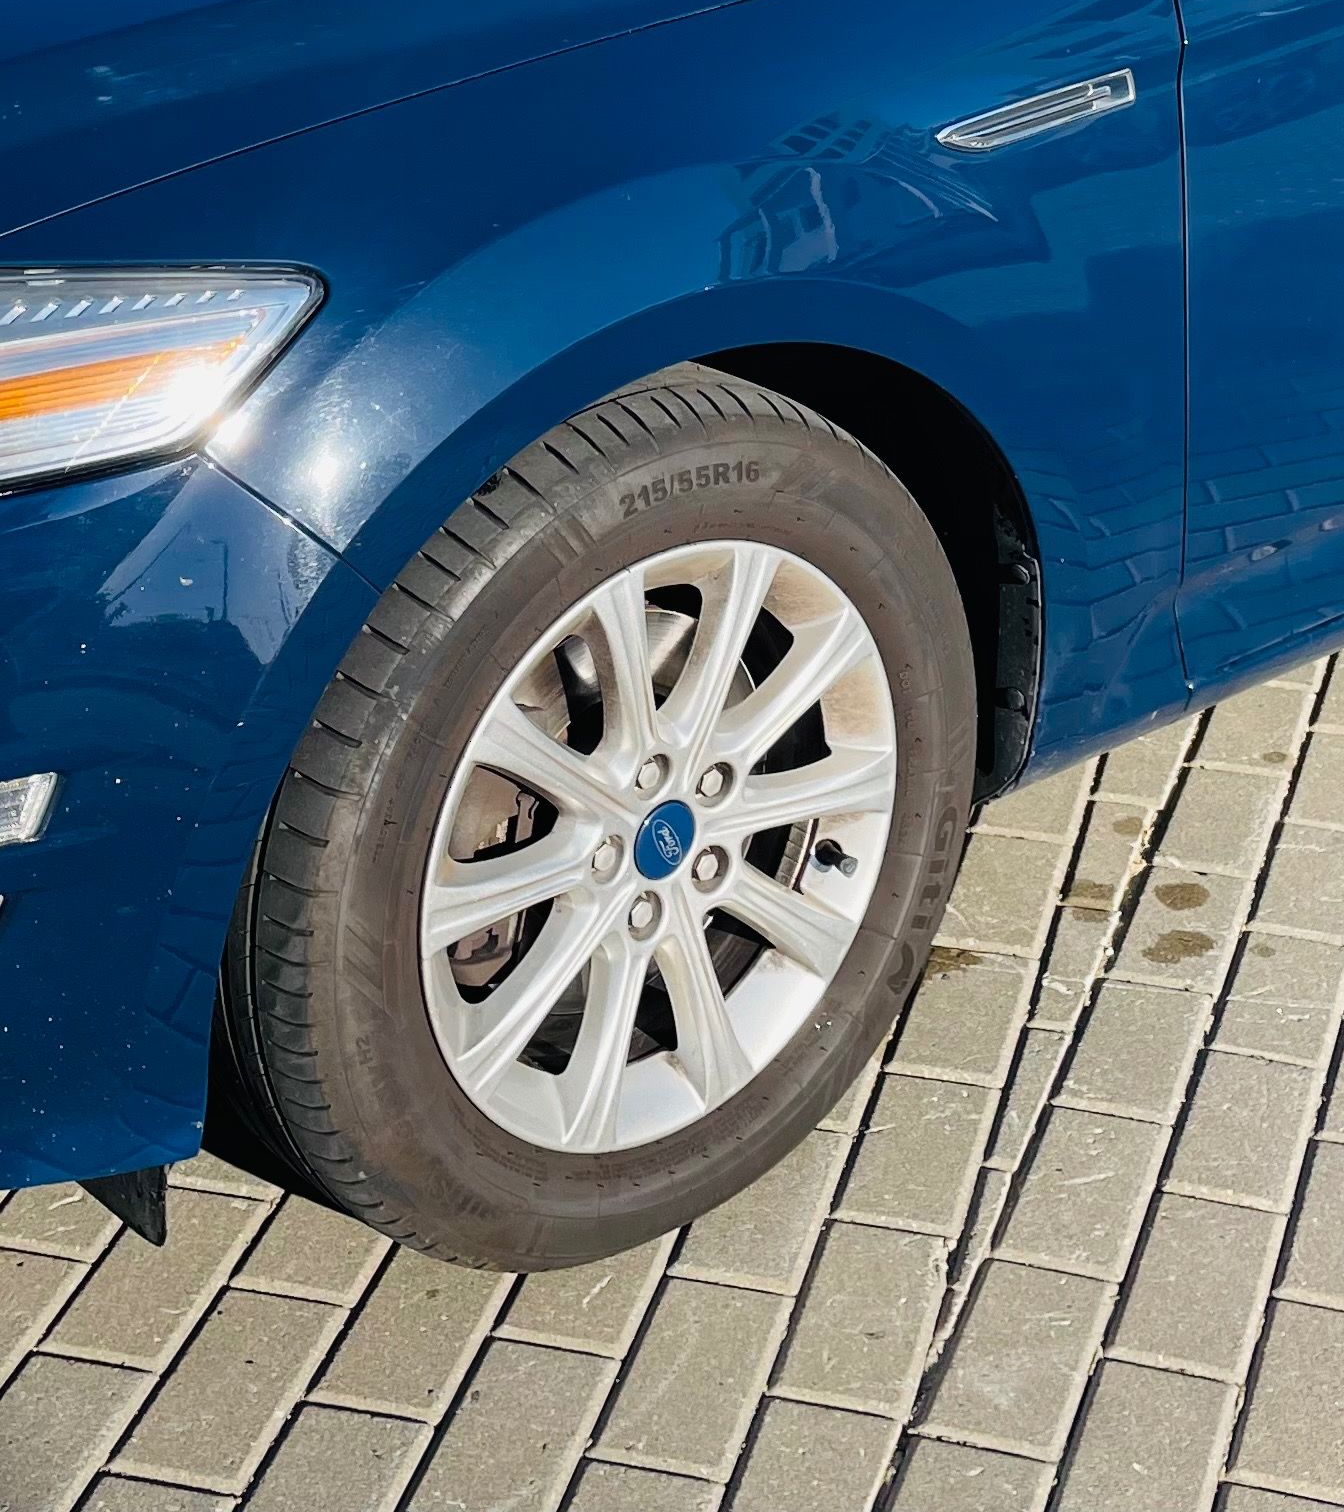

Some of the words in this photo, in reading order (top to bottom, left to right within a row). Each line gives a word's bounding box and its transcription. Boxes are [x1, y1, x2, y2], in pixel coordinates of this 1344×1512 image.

[619, 460, 760, 520] 215/55R16
[657, 826, 680, 858] Ford
[909, 805, 958, 932] Giti
